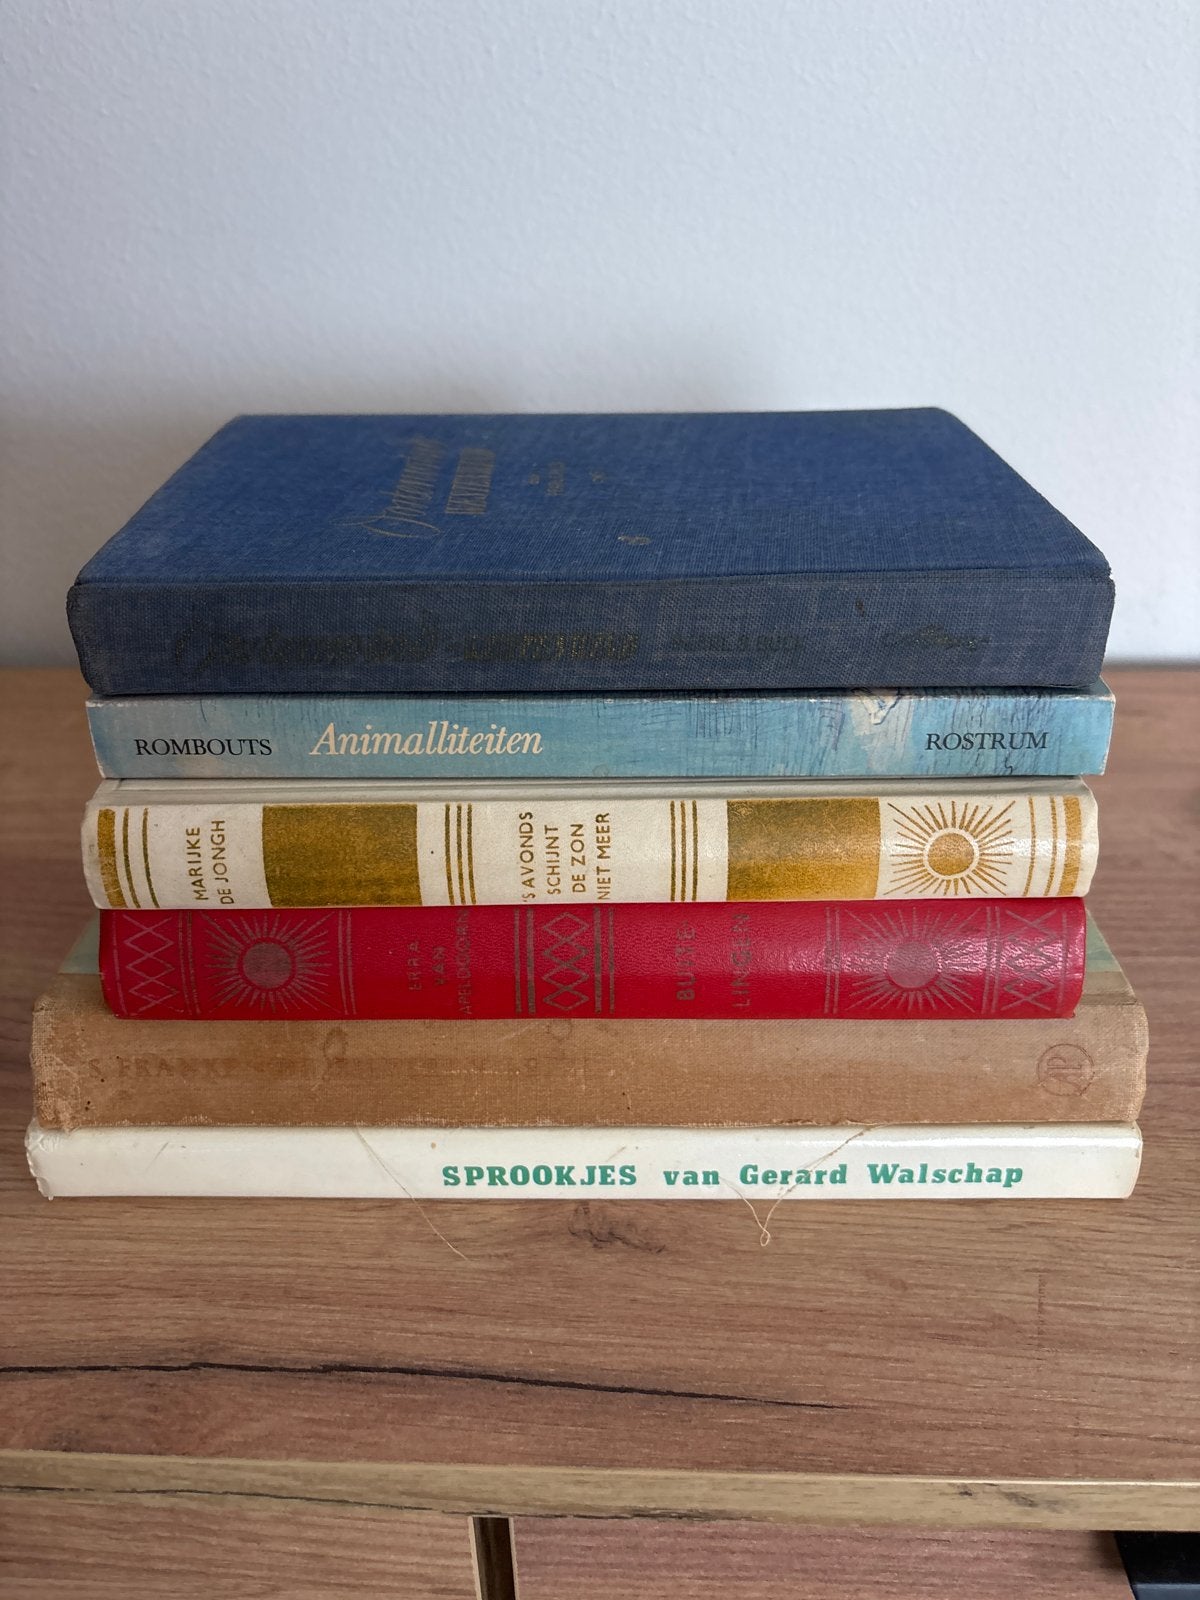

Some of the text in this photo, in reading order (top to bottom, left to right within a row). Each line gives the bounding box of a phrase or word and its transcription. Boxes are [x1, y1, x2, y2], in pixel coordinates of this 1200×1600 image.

[134, 738, 273, 756] ROMBOUTS
[308, 720, 543, 756] Animalliteiten
[925, 731, 1049, 751] ROSTRUM
[186, 827, 209, 901] MARIJKE
[210, 820, 235, 905] DE JONGH
[519, 811, 536, 889] AVONDS
[544, 824, 562, 895] SCHIJNT
[570, 824, 587, 893] DE ZON
[595, 812, 612, 900] NIET MEER
[442, 1162, 1023, 1188] SPROOKJES van Gerard Walschap
